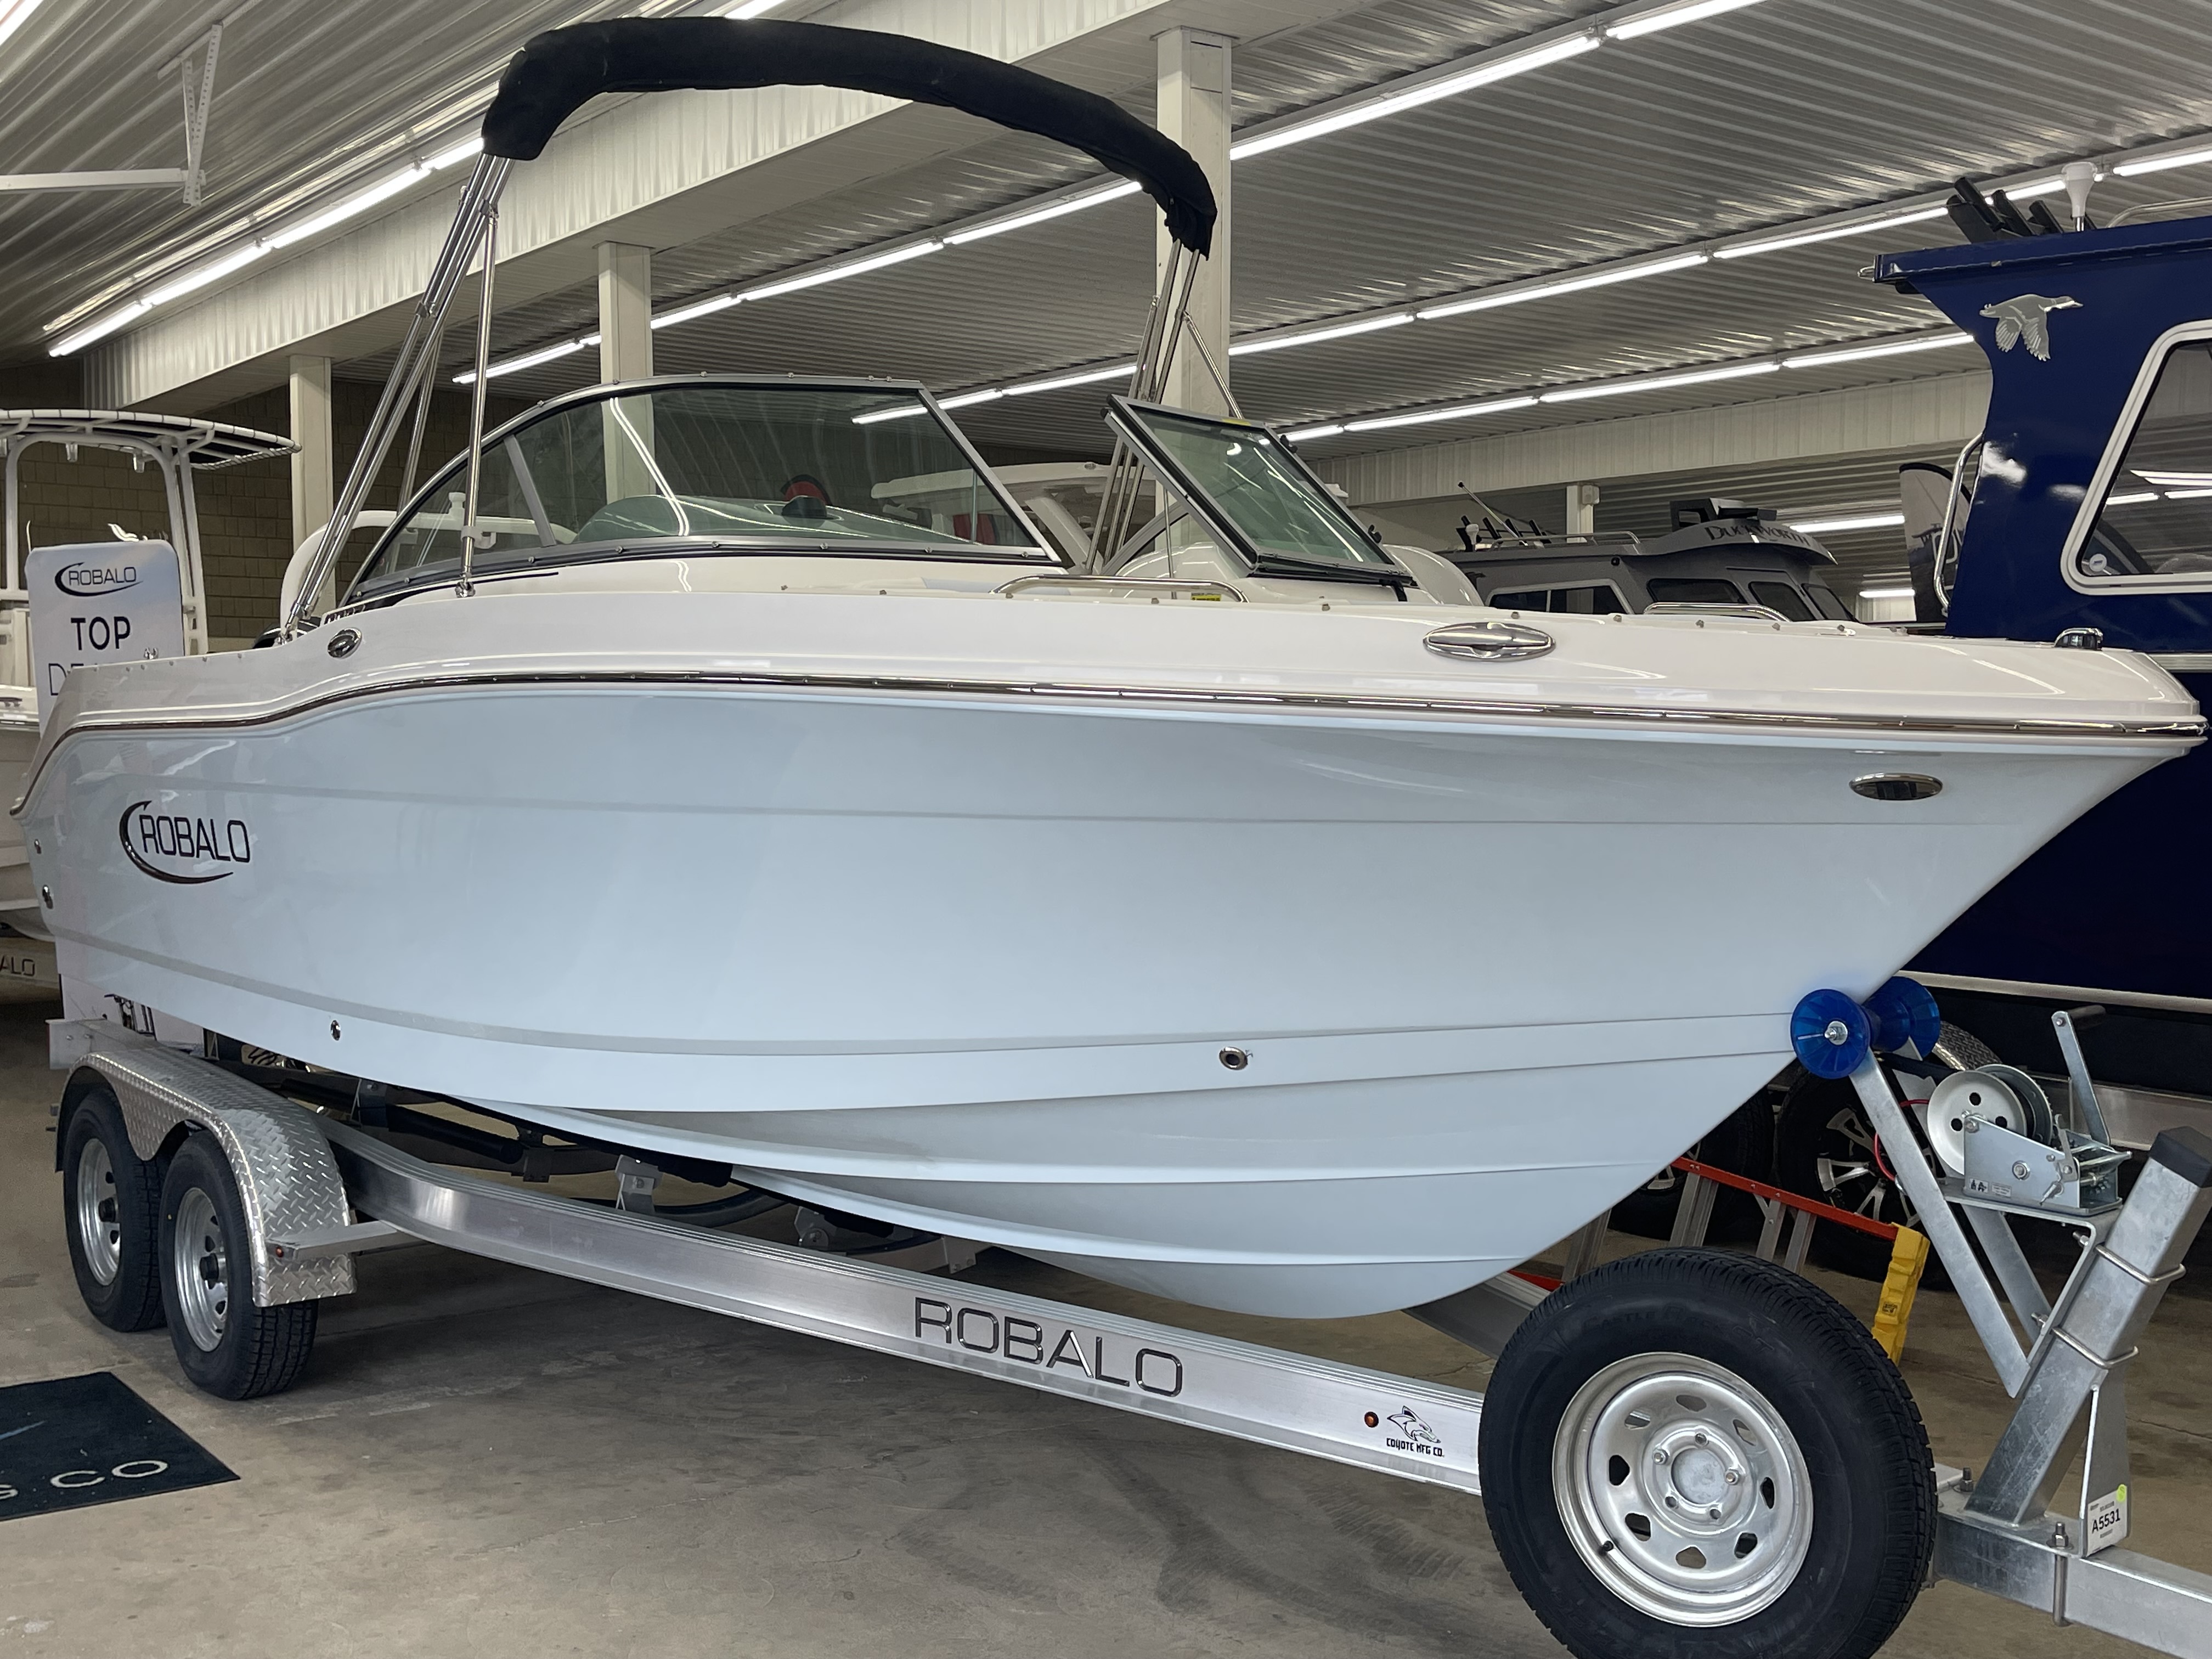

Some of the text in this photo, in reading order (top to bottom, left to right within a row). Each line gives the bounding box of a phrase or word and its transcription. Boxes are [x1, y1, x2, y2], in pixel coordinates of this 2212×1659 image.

[68, 566, 137, 586] ROBALO
[70, 616, 131, 651] TOP
[139, 814, 251, 863] ROBALO
[915, 1296, 1183, 1398] ROBALO
[1386, 1437, 1415, 1452] COYOTE
[50, 1459, 168, 1488] CO
[2092, 1508, 2121, 1534] A5531
